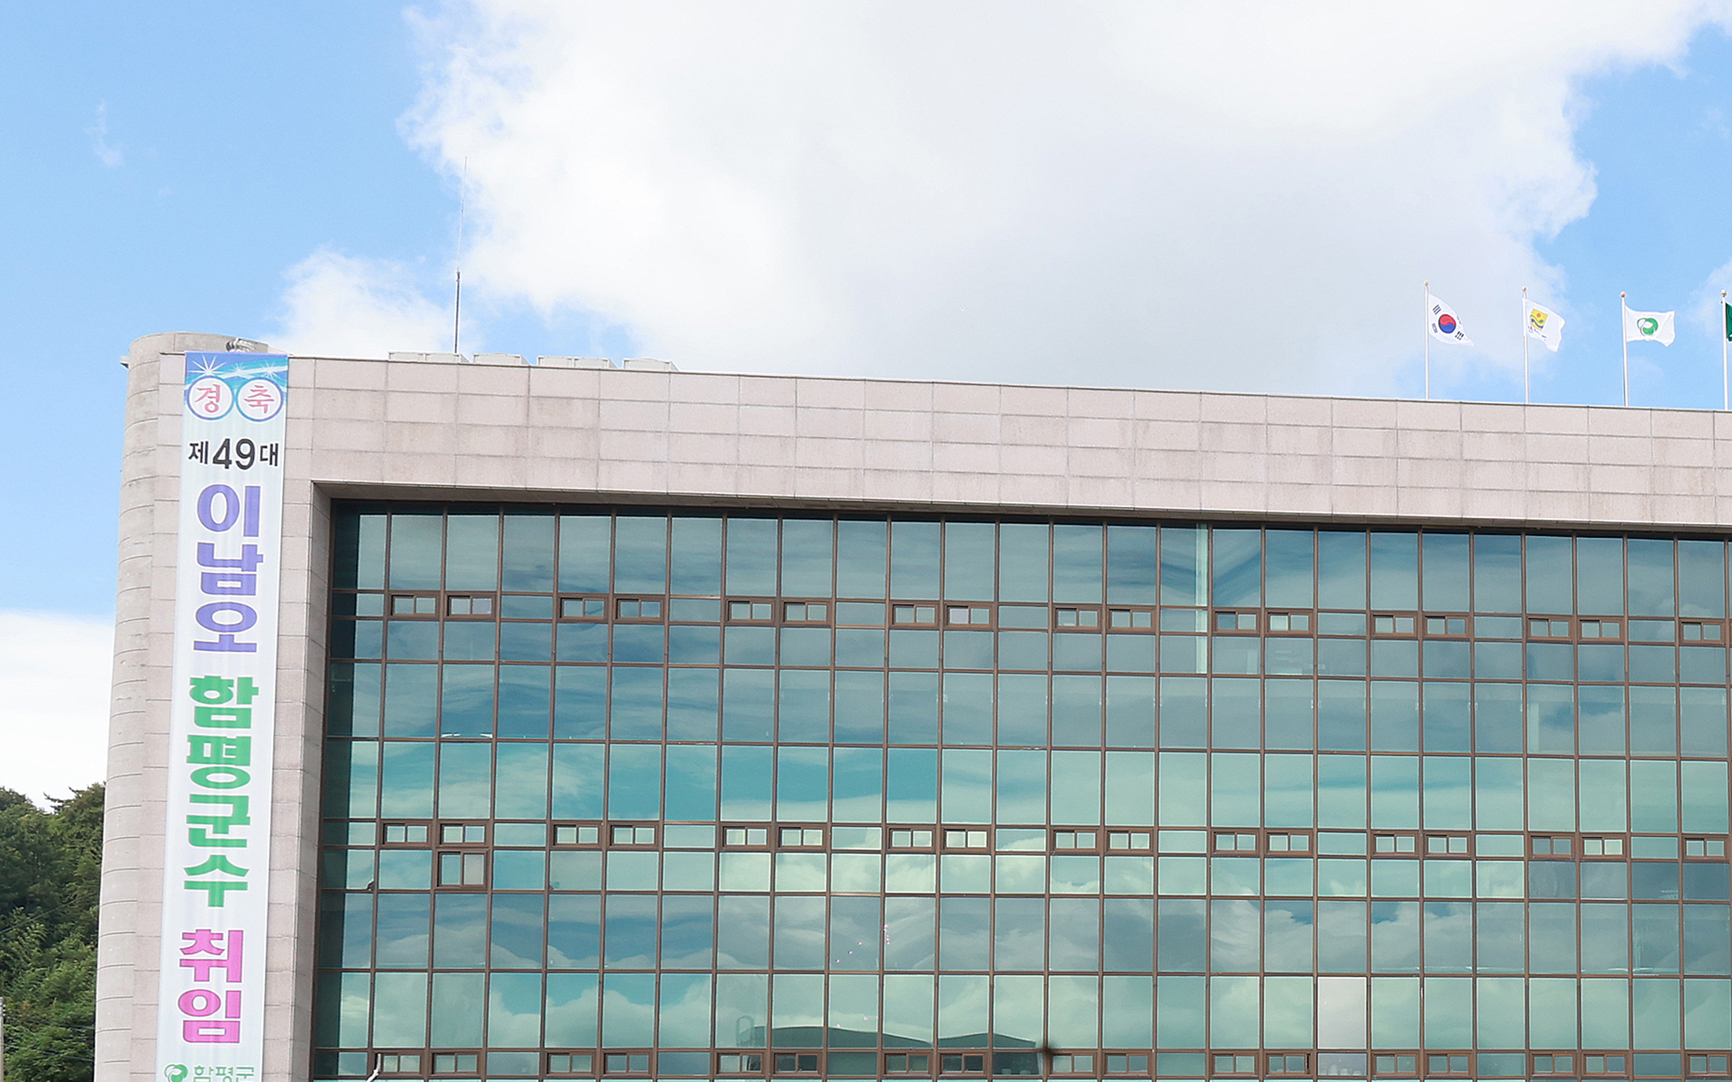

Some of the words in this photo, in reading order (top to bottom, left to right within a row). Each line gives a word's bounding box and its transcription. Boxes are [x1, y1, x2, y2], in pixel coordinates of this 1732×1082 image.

[188, 438, 279, 470] 제49대
[194, 383, 275, 414] 경축
[193, 483, 264, 654] 이남오
[183, 674, 260, 908] 함평군수
[177, 928, 245, 1045] 취임
